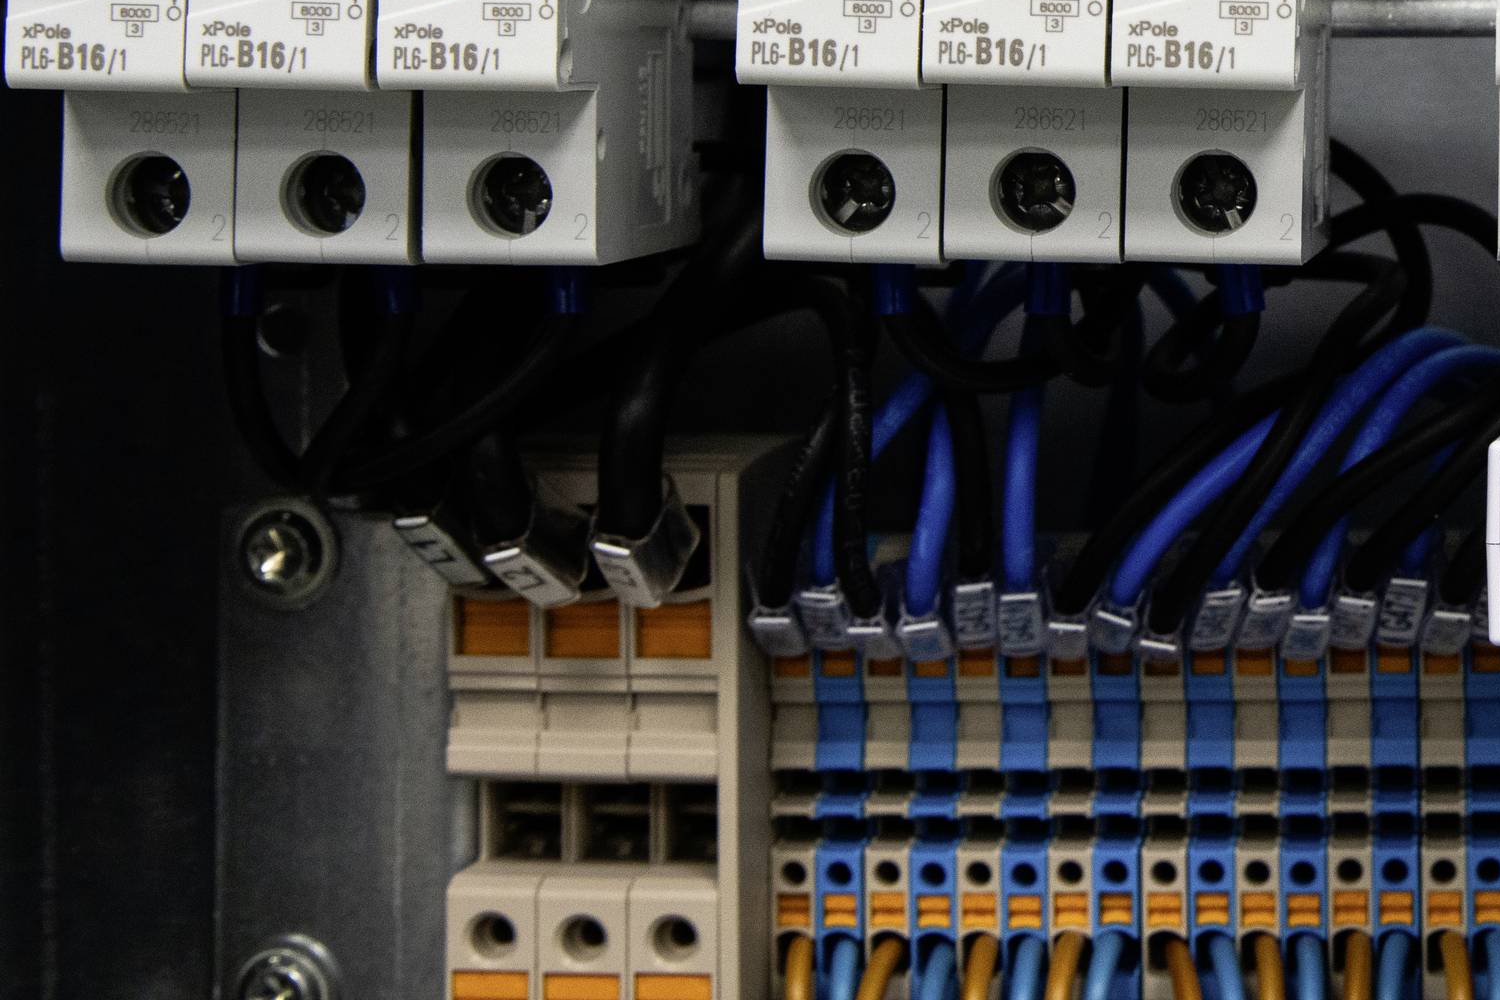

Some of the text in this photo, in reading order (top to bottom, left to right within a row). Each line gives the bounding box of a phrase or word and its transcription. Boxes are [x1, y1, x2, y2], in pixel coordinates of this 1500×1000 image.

[120, 8, 151, 18] 6000
[300, 6, 332, 16] 6000
[492, 7, 524, 17] 6000
[852, 3, 885, 14] 6000
[1039, 3, 1072, 13] 6000
[1228, 5, 1261, 16] 6000
[131, 24, 140, 34] 3
[202, 21, 252, 37] xPole
[312, 22, 320, 32] 3
[503, 23, 512, 33] 3
[752, 18, 803, 35] xPole
[863, 20, 872, 30] 3
[939, 17, 990, 34] xPole
[1050, 18, 1060, 29] 3
[1128, 20, 1179, 37] xPole
[1240, 21, 1249, 32] 3
[22, 24, 71, 40] xPole
[394, 23, 444, 40] xPole
[210, 213, 226, 242] 2
[385, 213, 400, 241] 2
[573, 212, 589, 241] 2
[916, 211, 932, 239] 2
[1097, 211, 1112, 240] 2
[1279, 212, 1294, 241] 2
